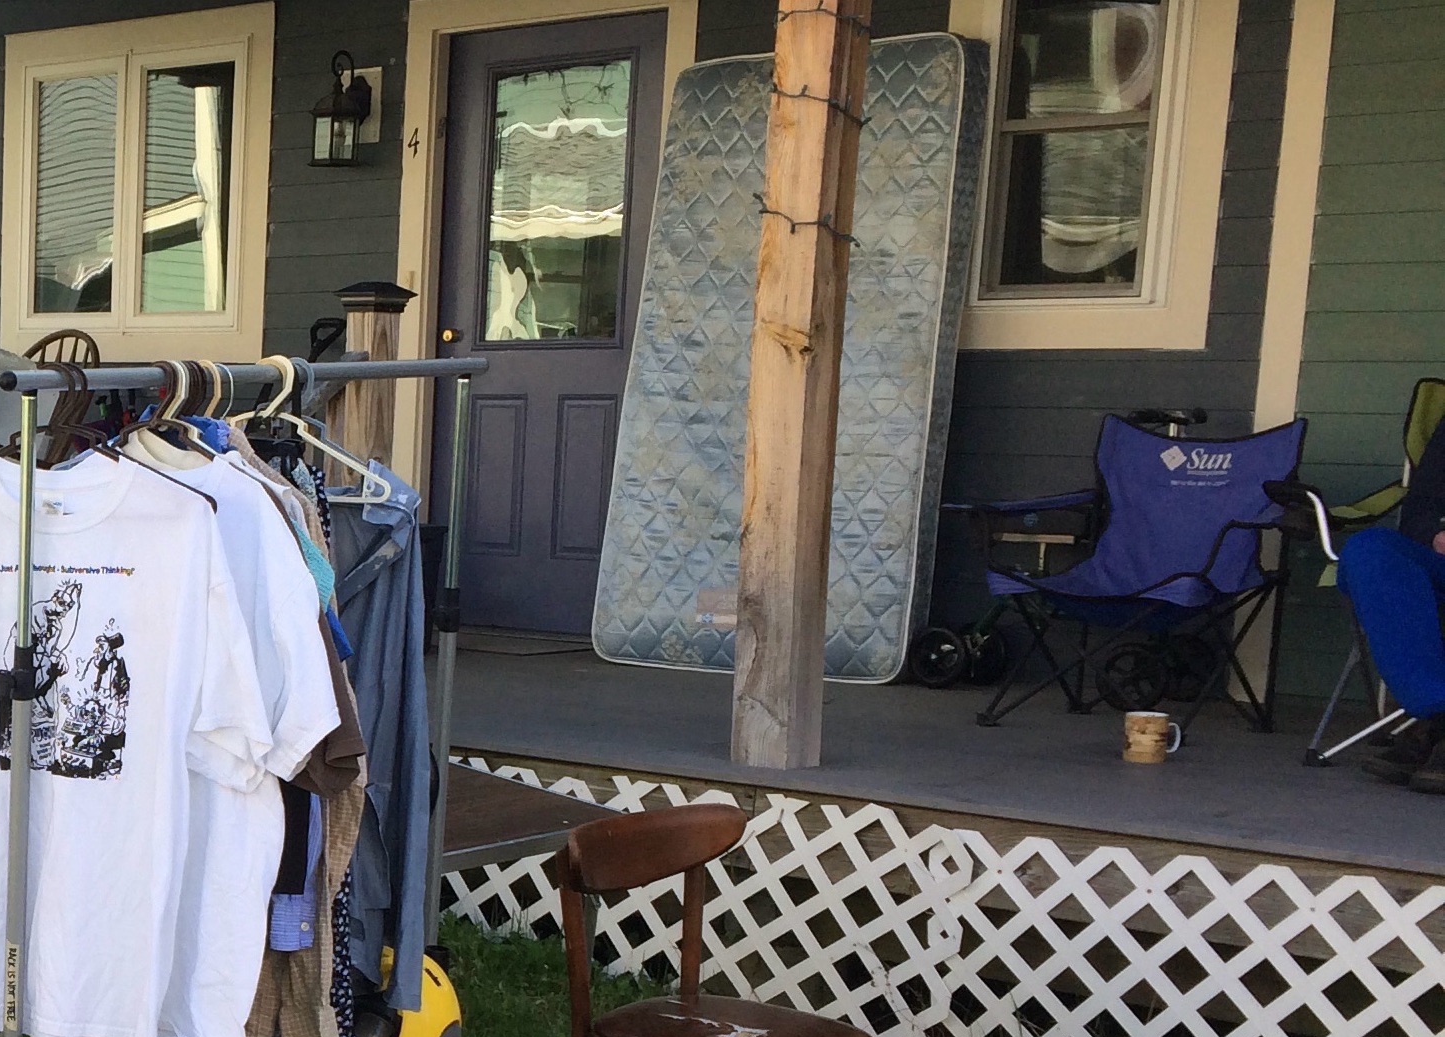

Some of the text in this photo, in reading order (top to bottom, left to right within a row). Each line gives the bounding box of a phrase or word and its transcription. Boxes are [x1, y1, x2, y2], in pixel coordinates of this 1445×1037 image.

[408, 128, 419, 158] 4
[1186, 448, 1232, 469] Sun
[61, 565, 100, 574] Subversive
[8, 971, 16, 979] IS
[7, 981, 16, 998] NOT
[6, 1000, 16, 1022] FREE
